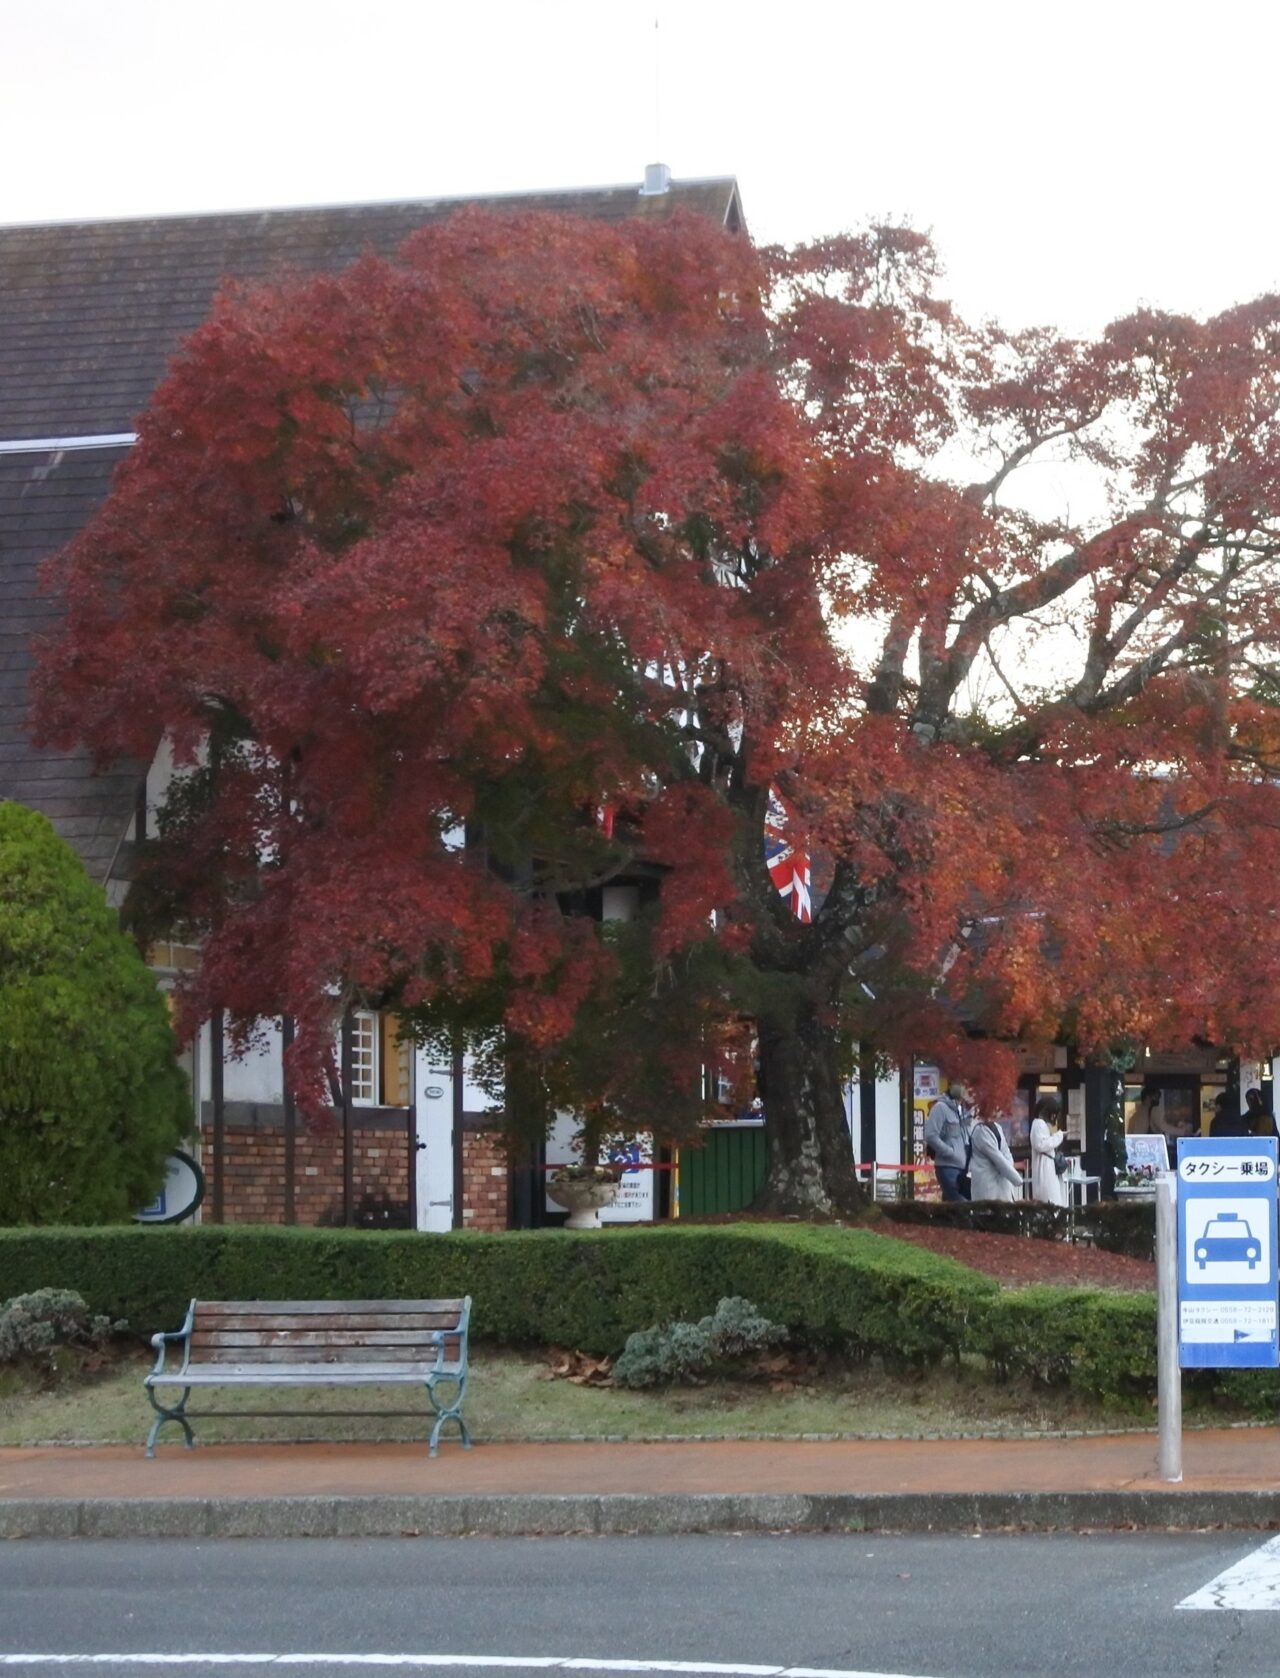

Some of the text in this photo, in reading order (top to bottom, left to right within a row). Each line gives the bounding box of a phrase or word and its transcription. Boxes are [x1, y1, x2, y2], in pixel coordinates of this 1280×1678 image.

[1185, 1161, 1269, 1176] タクシー乗場
